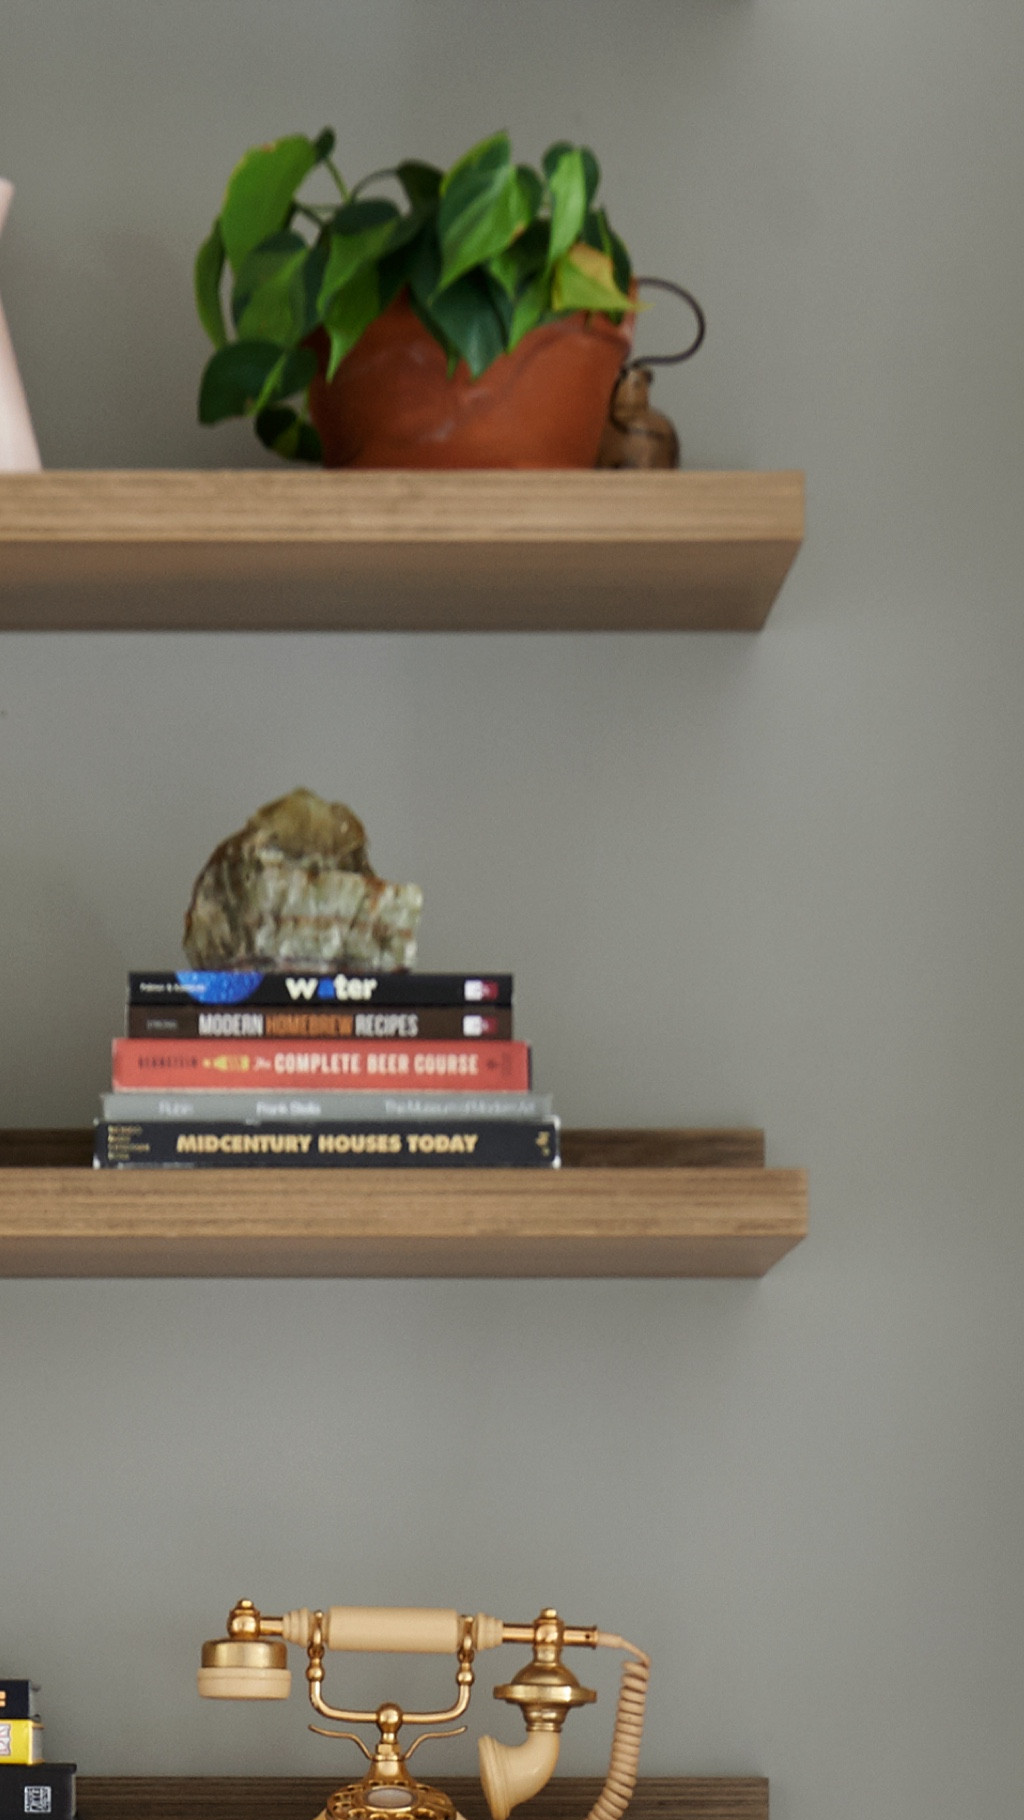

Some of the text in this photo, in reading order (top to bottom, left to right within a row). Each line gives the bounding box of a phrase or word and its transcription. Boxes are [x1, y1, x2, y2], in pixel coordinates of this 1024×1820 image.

[198, 1012, 264, 1037] MODERN
[265, 1013, 354, 1037] HOMEBREW
[355, 1013, 419, 1037] RECIPES
[274, 1051, 361, 1075] COMPLETE
[367, 1052, 409, 1076] BEER
[414, 1052, 479, 1076] COURSE
[177, 1133, 479, 1154] MIDCENTURY HOUSES TODAY
